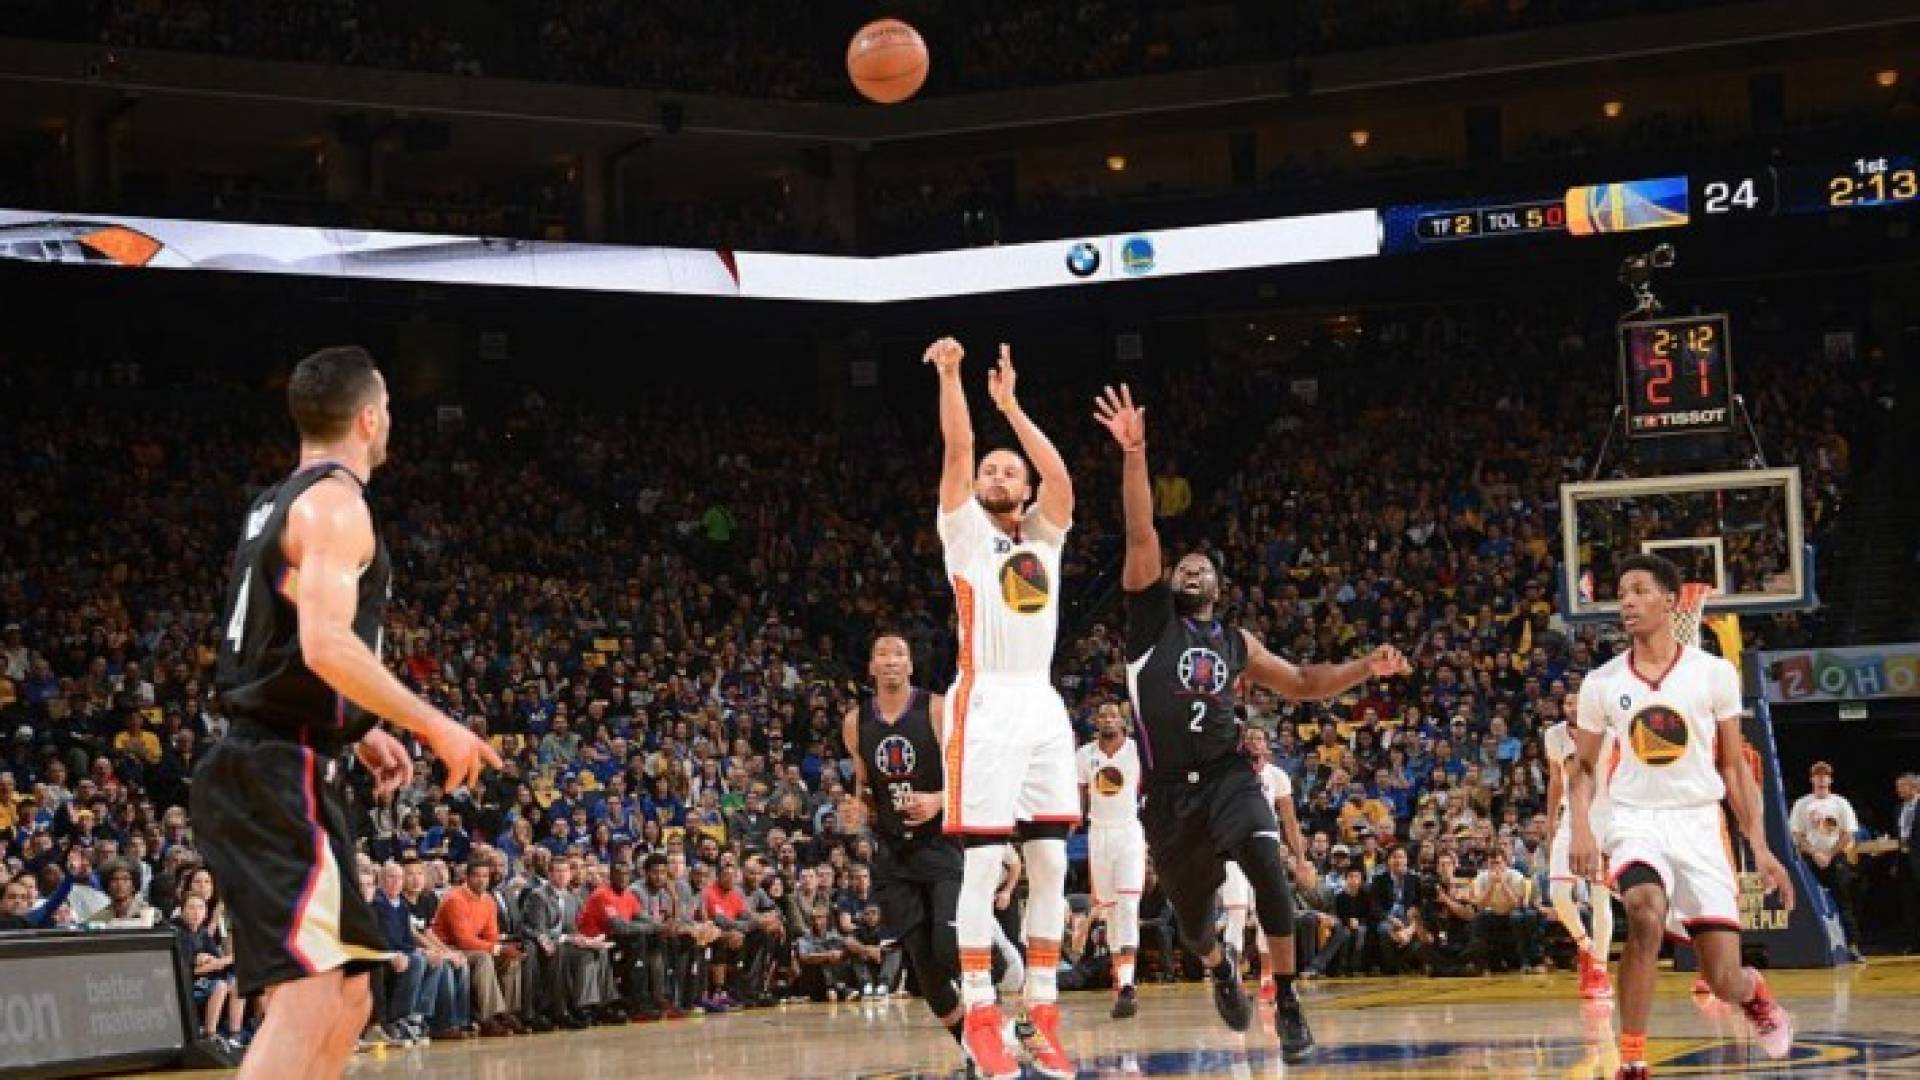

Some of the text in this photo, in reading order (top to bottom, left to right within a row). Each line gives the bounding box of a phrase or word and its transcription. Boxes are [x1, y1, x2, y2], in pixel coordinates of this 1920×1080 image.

[1855, 157, 1888, 173] 1st
[1705, 179, 1758, 213] 24
[1829, 169, 1917, 206] 2:13
[1455, 215, 1472, 233] 2
[1488, 211, 1520, 230] TOL
[1654, 326, 1713, 356] 2:12
[1646, 358, 1709, 404] 21
[1660, 407, 1726, 425] TISSOT
[226, 565, 252, 653] 4
[1784, 666, 1916, 697] ZOHO
[1189, 701, 1207, 732] 2
[86, 972, 146, 1003] better
[88, 1003, 169, 1037] matters
